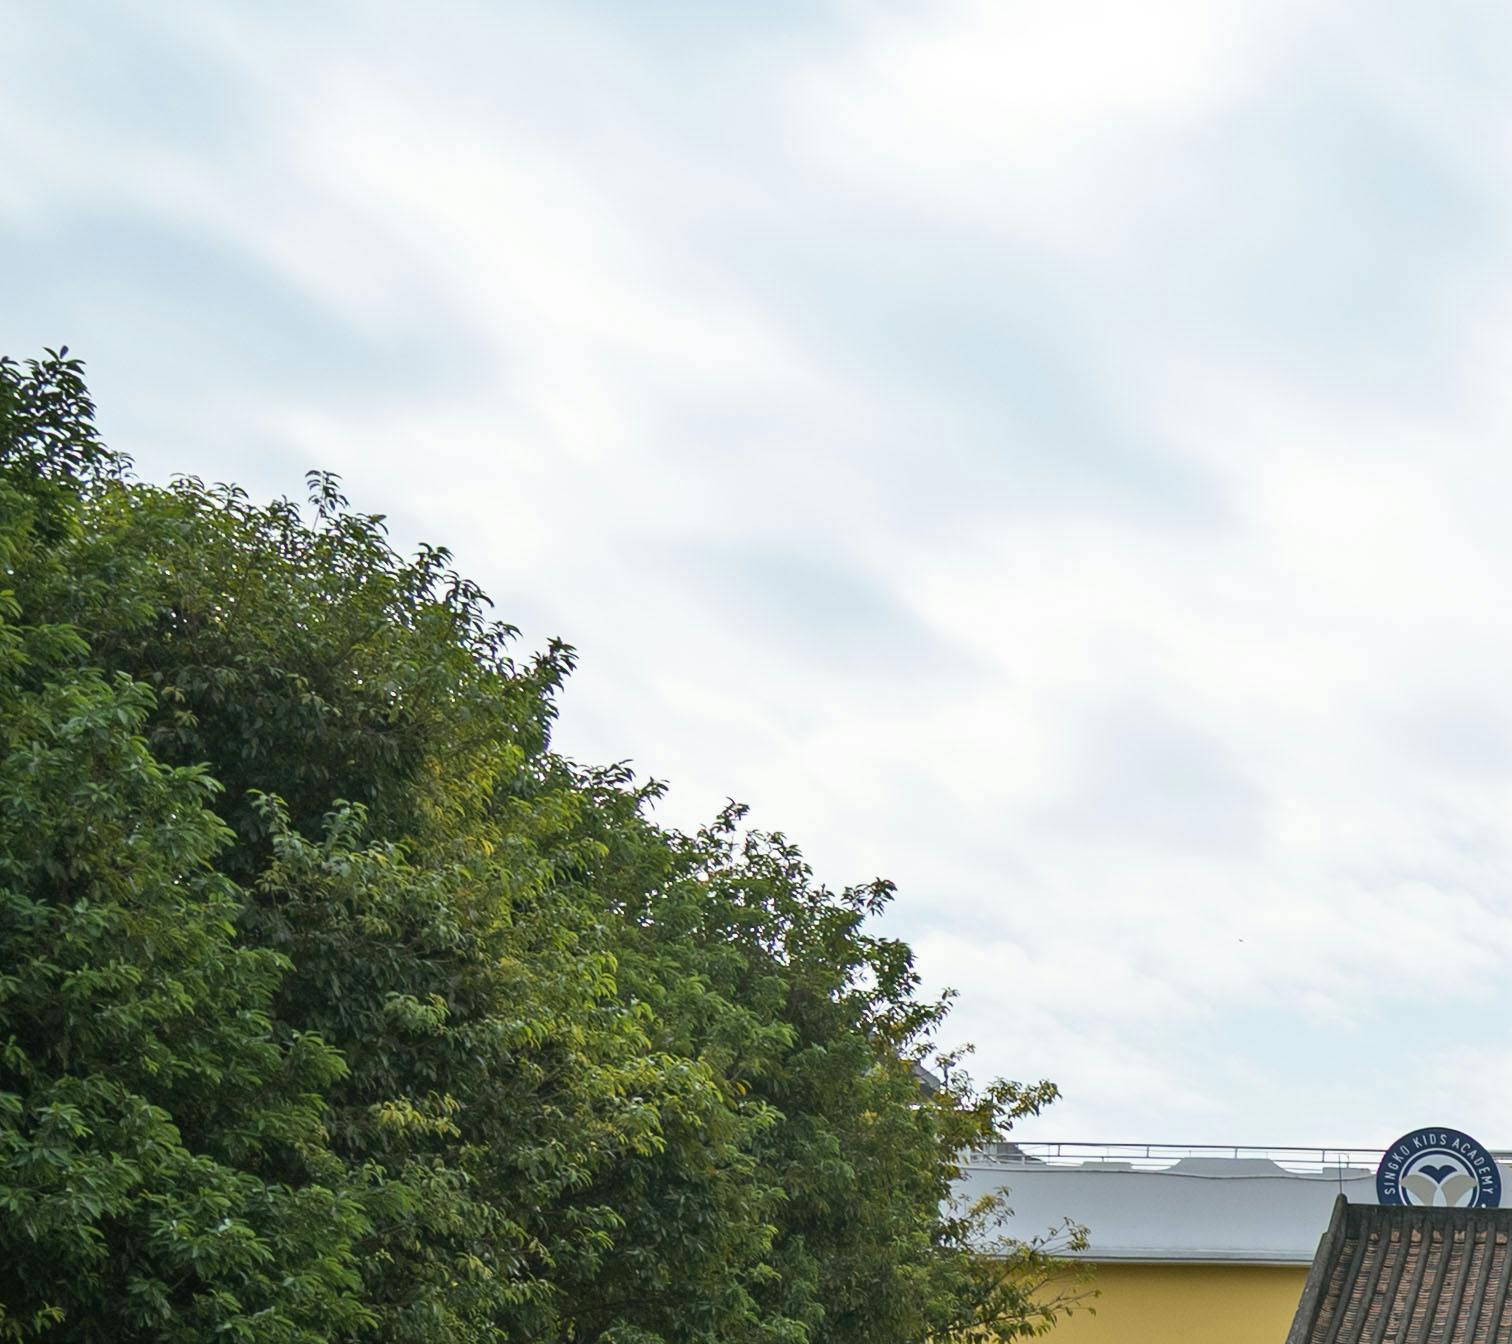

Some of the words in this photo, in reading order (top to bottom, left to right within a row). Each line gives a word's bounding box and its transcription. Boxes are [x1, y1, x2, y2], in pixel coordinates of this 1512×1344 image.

[1384, 1145, 1411, 1195] SINGKO
[1412, 1133, 1448, 1149] KIDS
[1452, 1138, 1494, 1195] ACADEMY
